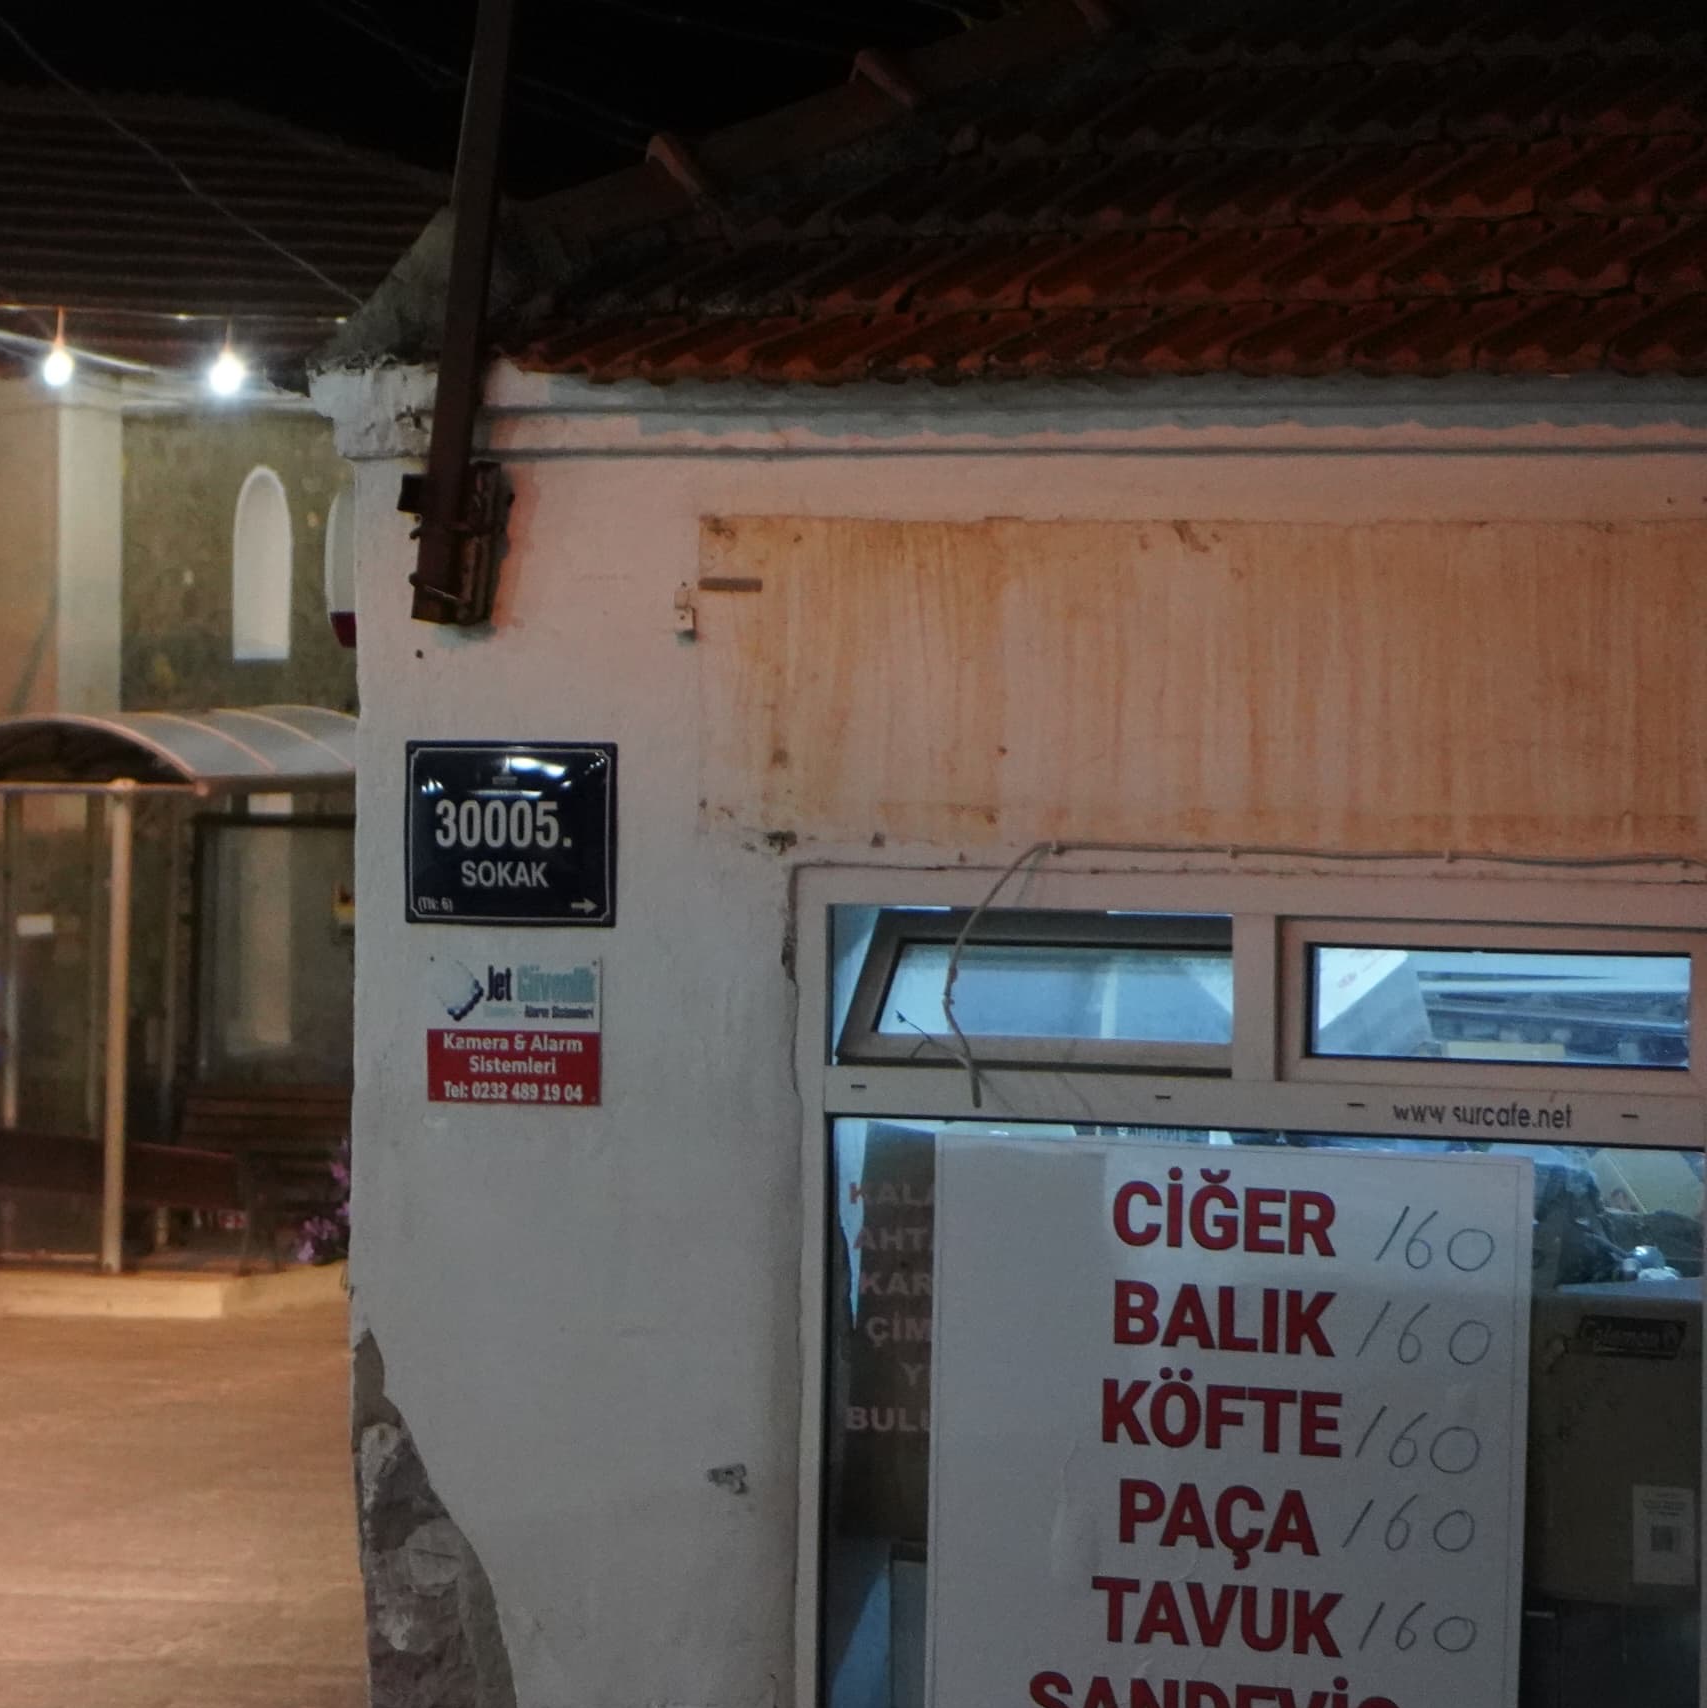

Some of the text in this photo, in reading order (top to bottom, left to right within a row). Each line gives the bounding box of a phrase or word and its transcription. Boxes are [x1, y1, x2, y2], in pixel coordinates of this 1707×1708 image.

[435, 799, 572, 848] 30005.
[461, 860, 550, 888] SOKAK
[486, 964, 512, 1001] Jet
[443, 1032, 584, 1053] Kamera & Alarm
[469, 1055, 557, 1074] Sistemleri
[443, 1080, 469, 1098] Tel:
[471, 1082, 507, 1099] 0232
[1112, 1166, 1336, 1257] CİĞER
[854, 1226, 933, 1249] AHT
[1113, 1279, 1337, 1358] BALIK
[1101, 1366, 1342, 1459] KÖFTE
[1119, 1478, 1320, 1570] PAÇA
[1092, 1575, 1344, 1658] TAVUK
